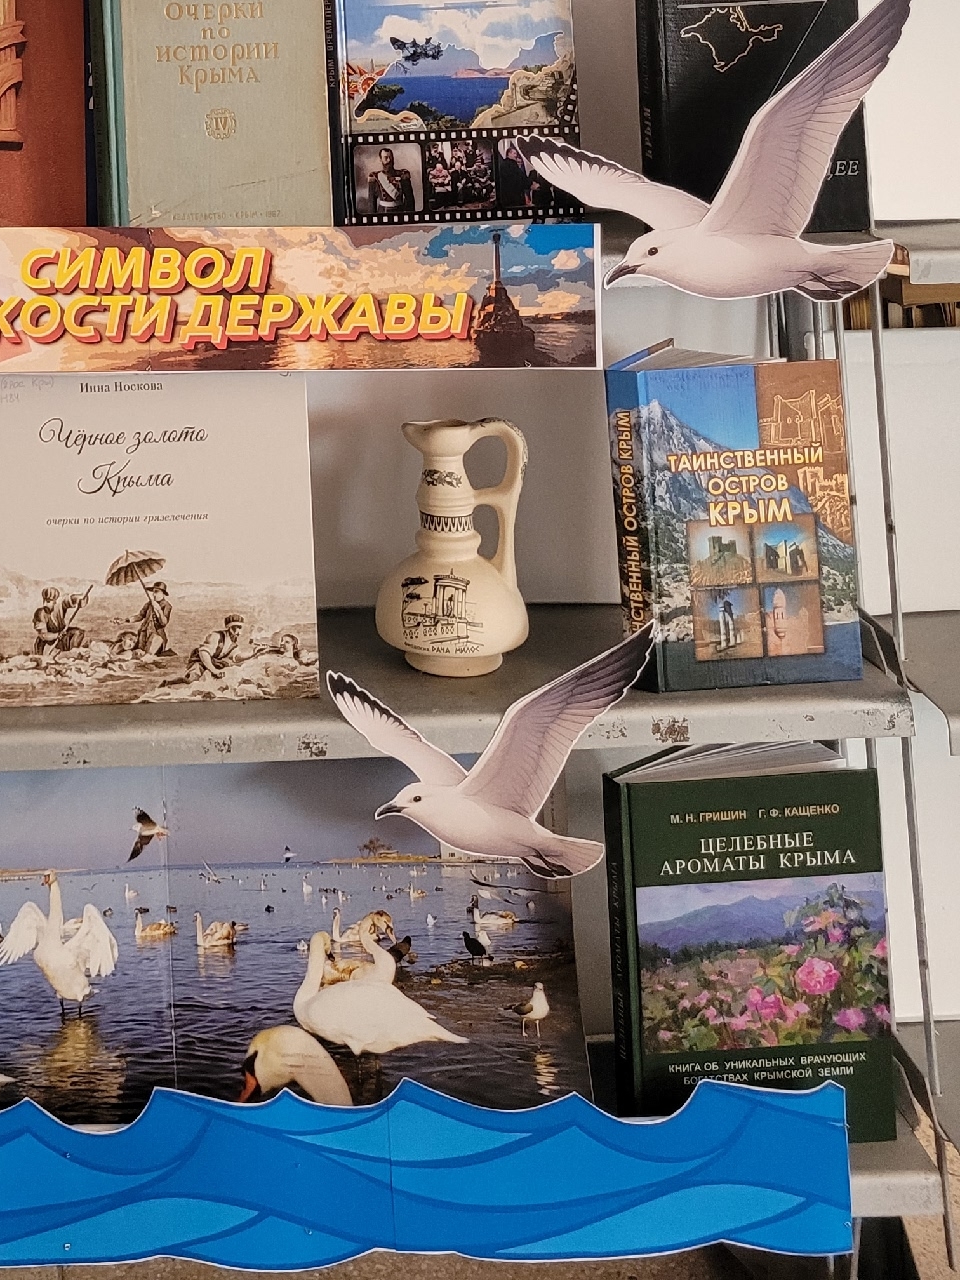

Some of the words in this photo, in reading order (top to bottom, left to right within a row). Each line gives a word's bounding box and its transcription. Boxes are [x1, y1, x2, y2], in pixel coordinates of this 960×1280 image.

[214, 117, 228, 131] IV
[19, 245, 270, 294] СИМВОЛ
[182, 291, 477, 349] ДЕРЖАВЫ
[79, 381, 110, 393] Инна
[114, 380, 164, 392] Носкова
[39, 417, 126, 455] Чёрное
[126, 425, 209, 454] золото
[617, 410, 631, 460] КРЫМ
[668, 441, 824, 472] ТАИНСТВЕННЫЙ
[77, 459, 175, 497] Крыма
[708, 473, 788, 495] ОСТРОВ
[620, 464, 638, 531] ОСТРОВ
[46, 517, 80, 527] очерки
[83, 517, 95, 525] по
[98, 515, 141, 525] истории
[142, 512, 209, 523] грязелечения
[708, 497, 793, 526] КРЫМ
[670, 814, 683, 824] М.
[686, 813, 698, 823] Н.
[699, 809, 746, 822] ГРИШИН
[758, 808, 767, 819] Г.
[770, 807, 781, 818] Ф.
[784, 804, 840, 818] КАЩЕНКО
[699, 831, 814, 855] ЦЕЛЕБНЫЕ
[660, 855, 765, 876] АРОМАТЫ
[779, 849, 856, 868] КРЫМА
[668, 1063, 701, 1073] КНИГА
[704, 1062, 719, 1071] ОБ
[724, 1057, 795, 1070] УНИКАЛЬНЫХ
[800, 1052, 867, 1065] ВРАЧУЮЩИХ
[754, 1067, 812, 1080] КРЫМСКОЙ
[818, 1066, 854, 1077] ЗЕМЛИ
